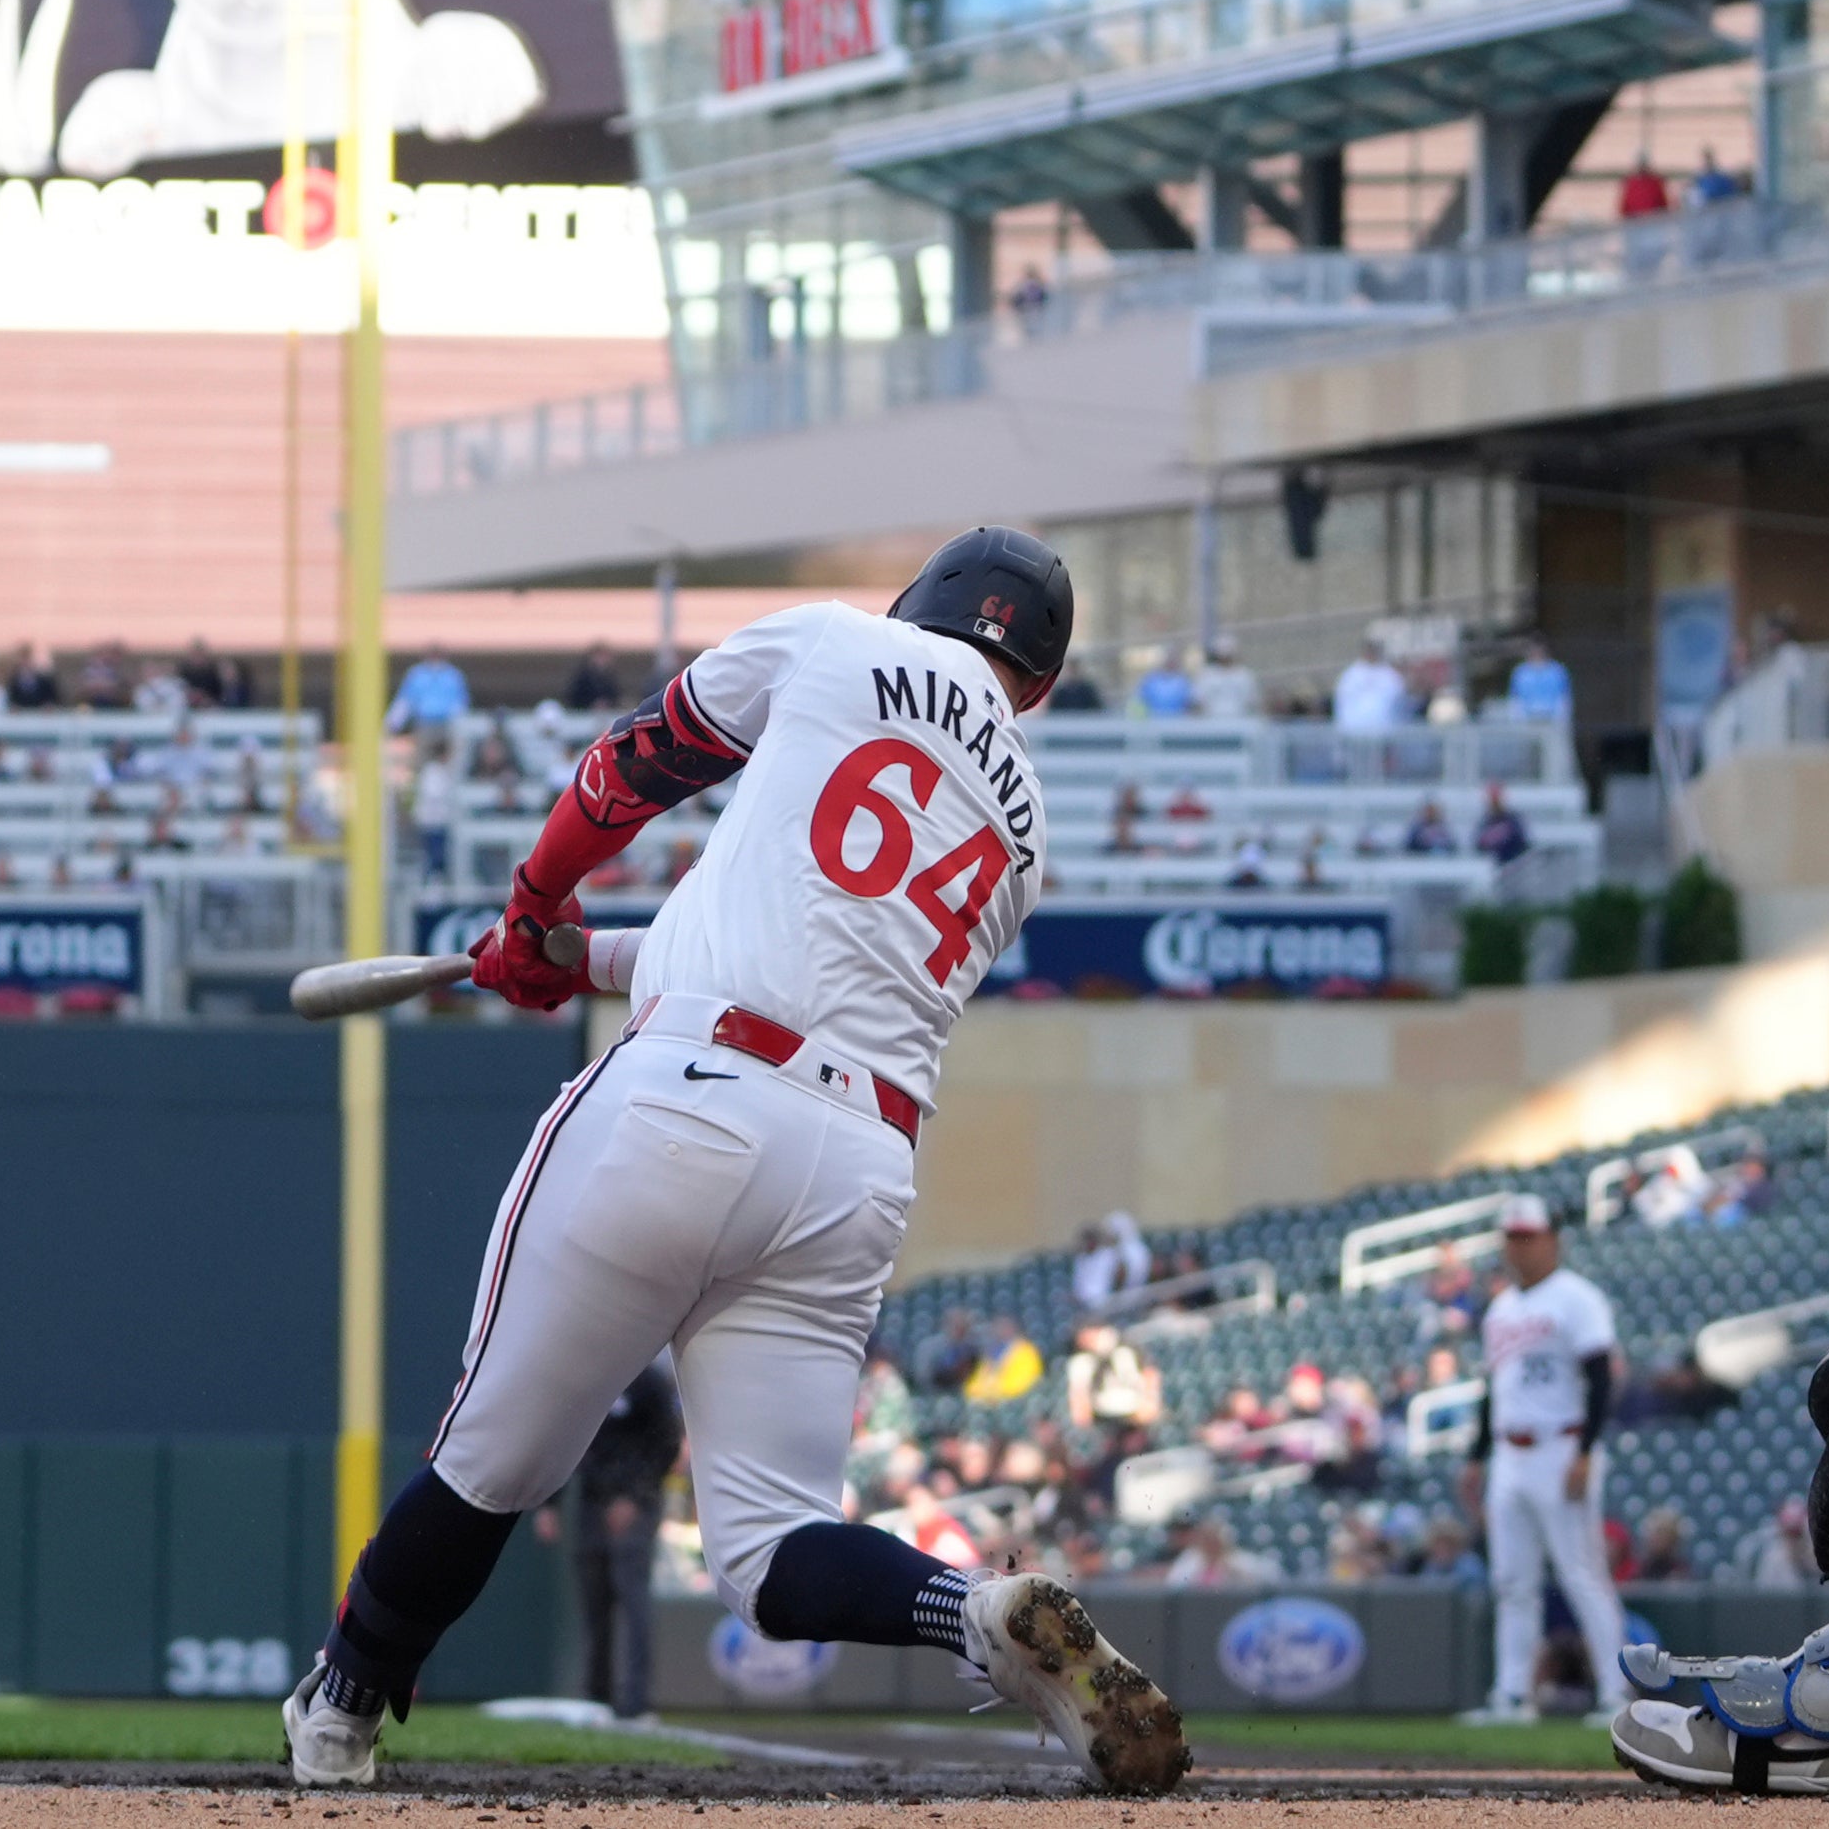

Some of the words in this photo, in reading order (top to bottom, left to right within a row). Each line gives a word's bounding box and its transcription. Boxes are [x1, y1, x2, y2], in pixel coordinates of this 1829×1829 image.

[980, 595, 1015, 626] 64
[871, 665, 1036, 876] MIRANDA
[809, 737, 1012, 988] 64
[1142, 907, 1385, 995] Corona
[165, 1635, 291, 1697] 328
